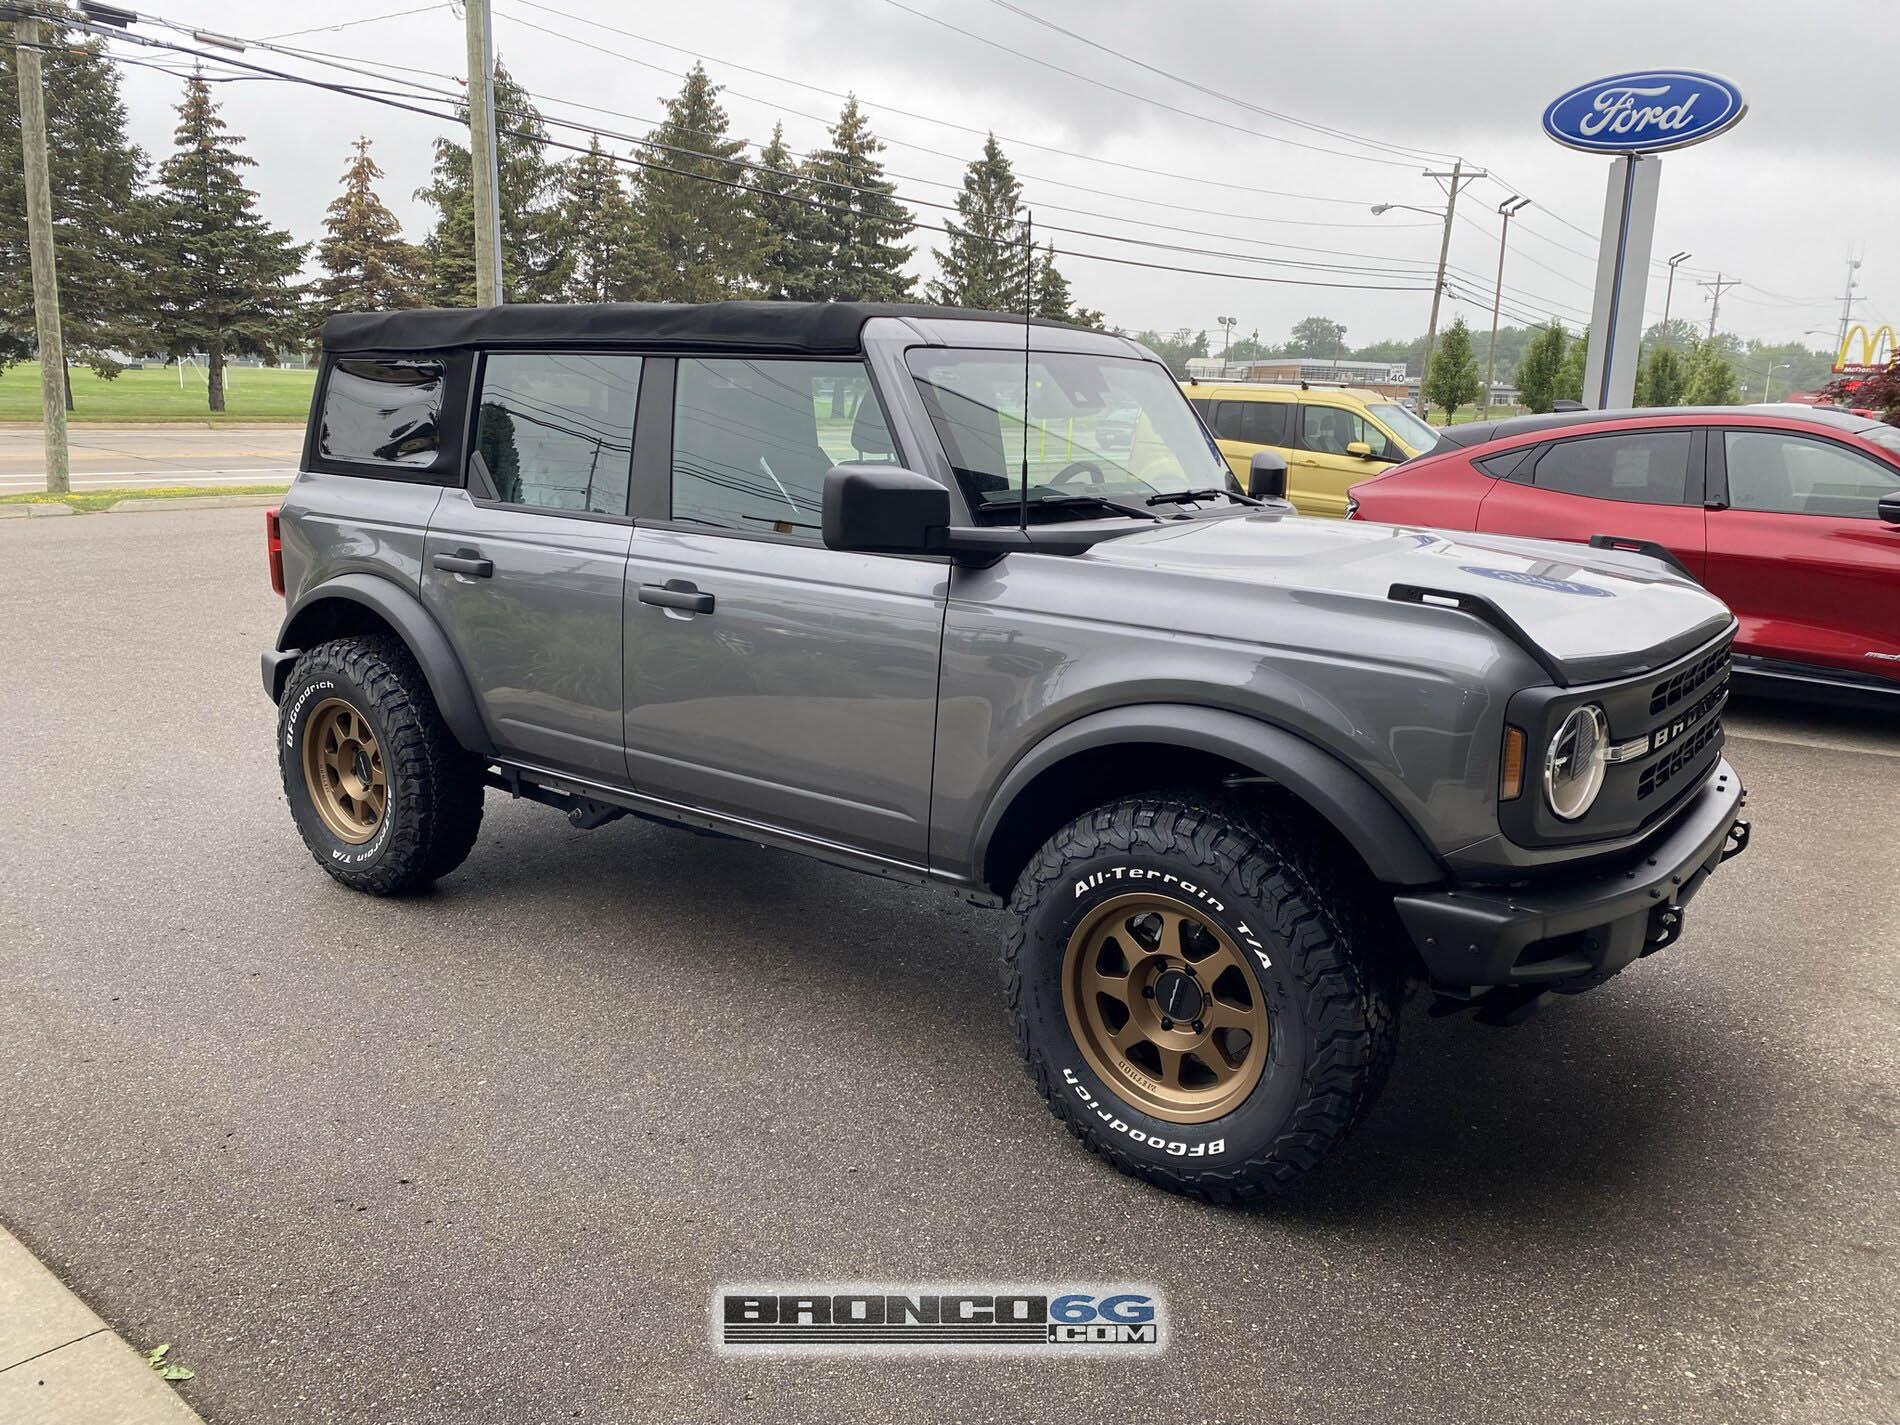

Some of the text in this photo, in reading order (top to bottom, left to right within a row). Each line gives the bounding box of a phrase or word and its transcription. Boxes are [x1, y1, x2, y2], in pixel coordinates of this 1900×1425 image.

[1579, 85, 1700, 136] Ford
[1391, 374, 1405, 382] 40
[286, 680, 334, 749] BFGoodrich
[331, 848, 352, 864] T/A
[1075, 866, 1272, 970] All-Terrain T/A
[1062, 1067, 1226, 1157] BFGoodrich
